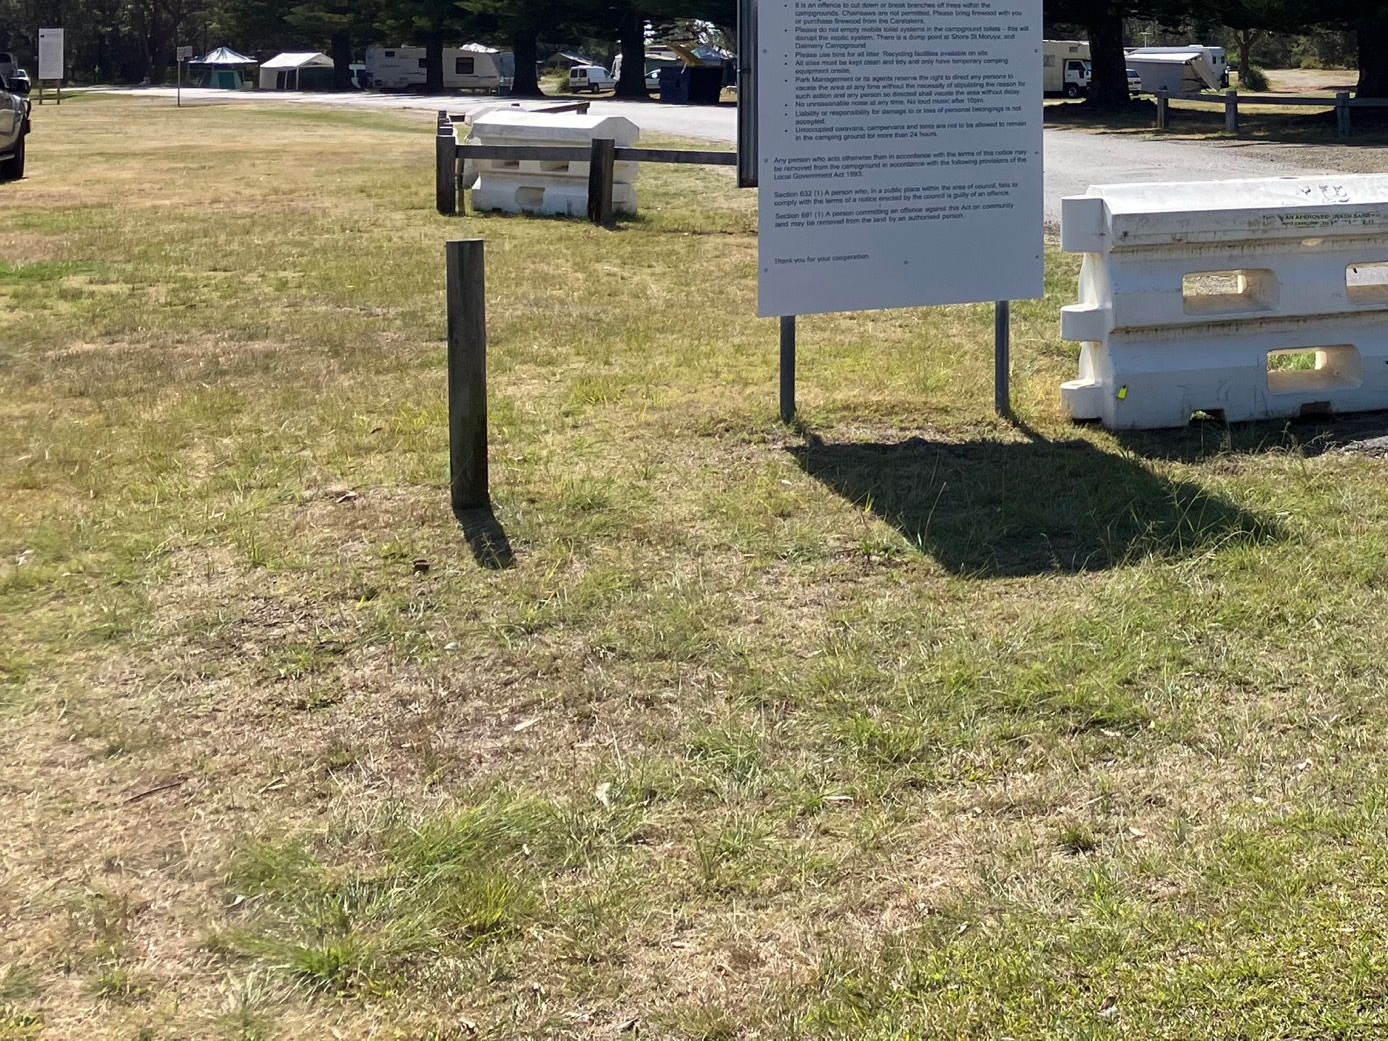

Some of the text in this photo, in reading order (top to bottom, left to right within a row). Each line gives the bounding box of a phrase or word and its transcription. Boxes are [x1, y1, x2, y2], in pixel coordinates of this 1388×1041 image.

[803, 18, 833, 26] purchase
[825, 42, 866, 50] Campground
[795, 68, 829, 76] equipment
[774, 199, 797, 207] comply
